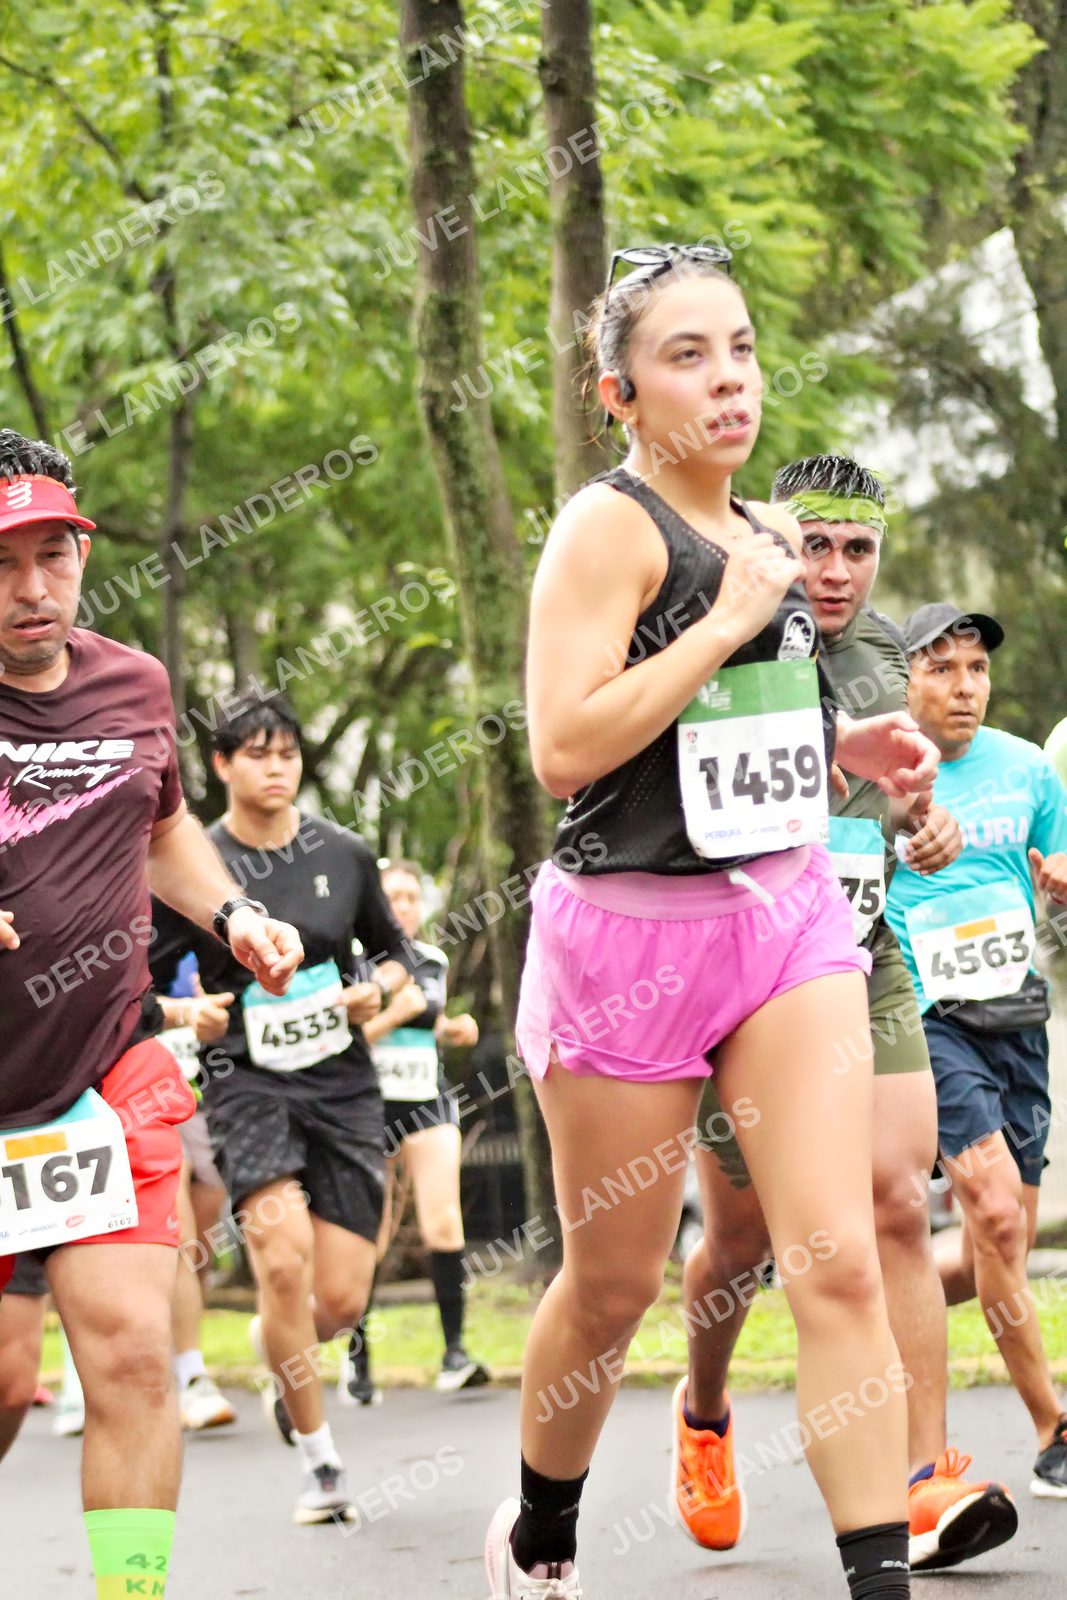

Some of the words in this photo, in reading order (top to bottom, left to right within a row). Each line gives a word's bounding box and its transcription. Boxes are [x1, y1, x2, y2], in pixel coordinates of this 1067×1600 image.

[0, 739, 135, 763] NIKE
[13, 763, 122, 790] Running
[699, 744, 822, 811] 1459
[931, 930, 1030, 980] 4563
[261, 1006, 341, 1048] 4533
[0, 1145, 113, 1211] 167
[126, 1553, 167, 1572] 42
